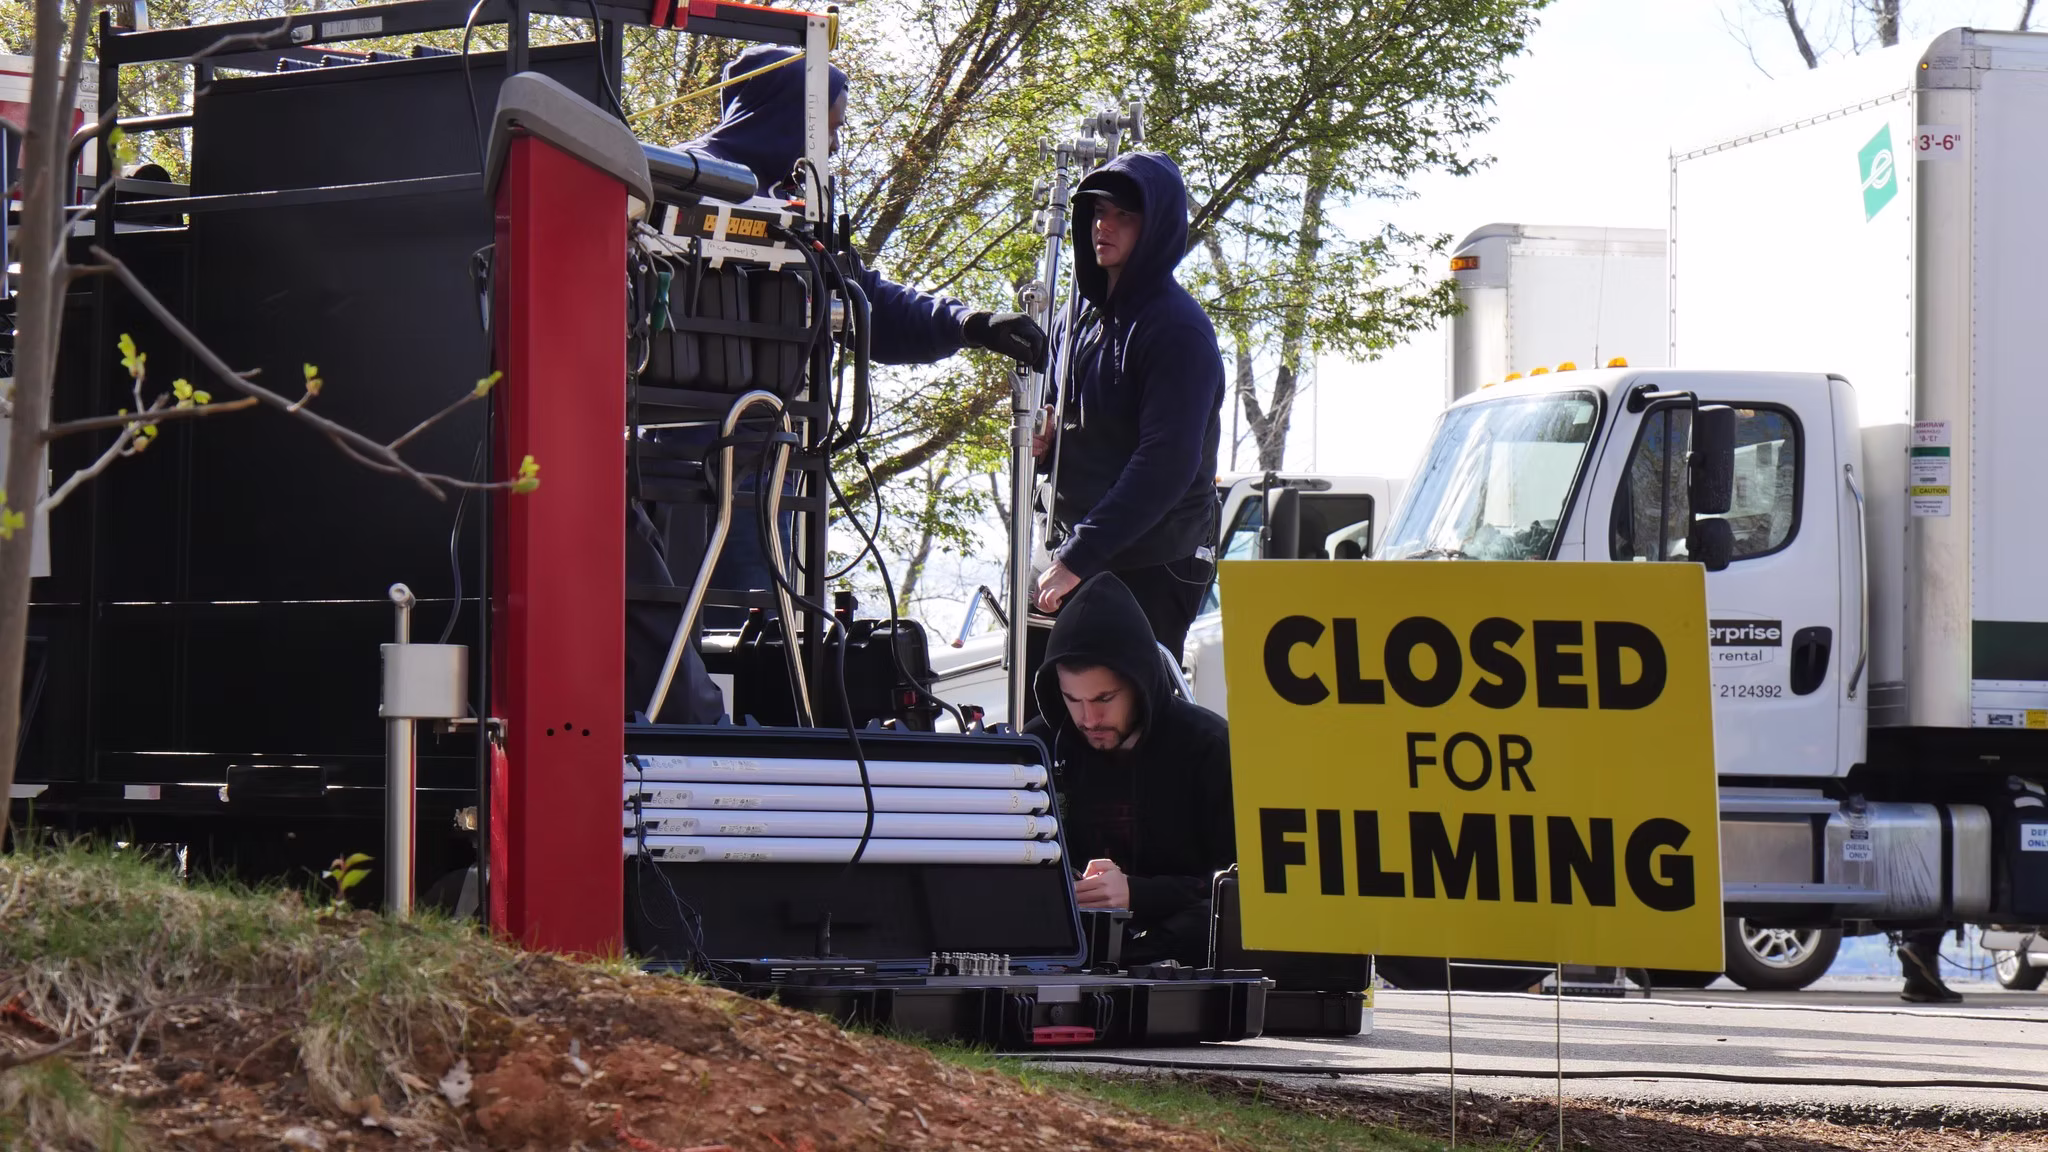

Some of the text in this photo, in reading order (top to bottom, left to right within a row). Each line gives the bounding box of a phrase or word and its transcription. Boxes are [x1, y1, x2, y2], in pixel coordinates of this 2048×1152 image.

[1263, 615, 1667, 710] CLOSED
[1719, 649, 1762, 661] rental
[1720, 684, 1782, 698] 2124392
[1406, 731, 1536, 791] FOR
[1259, 808, 1696, 912] FILMING
[1845, 843, 1871, 851] DIESEL
